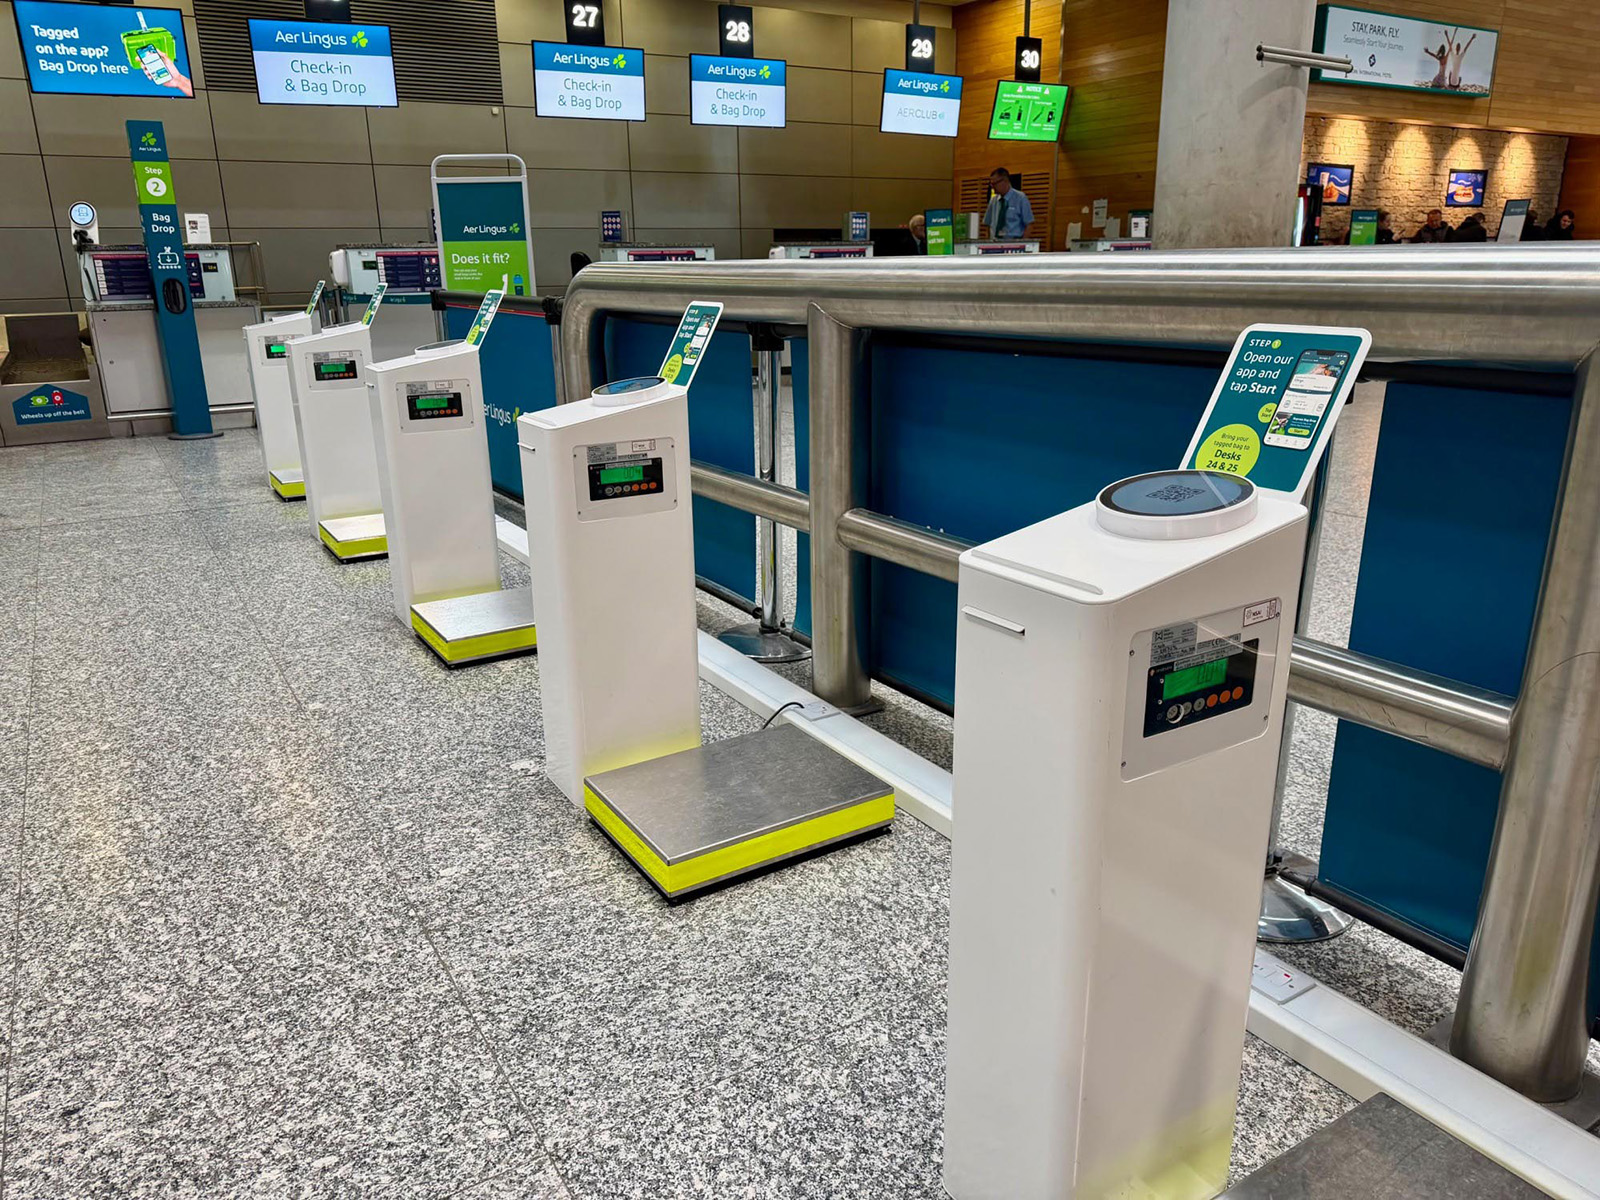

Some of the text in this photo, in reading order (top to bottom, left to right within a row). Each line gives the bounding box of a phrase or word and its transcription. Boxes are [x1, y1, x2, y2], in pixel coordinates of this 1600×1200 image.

[572, 4, 599, 27] 27
[30, 25, 79, 40] Tagged
[726, 20, 750, 42] 28
[275, 30, 347, 49] Aer Lingus
[36, 43, 109, 58] on the app?
[912, 39, 932, 58] 29
[553, 52, 610, 69] Aer Lingus
[1021, 50, 1039, 68] 30
[38, 59, 129, 75] Bag Drop here
[290, 60, 352, 74] Check-in
[708, 64, 756, 80] Aer Lingus
[285, 78, 366, 96] & Bag Drop
[564, 78, 612, 92] Check-in
[898, 78, 938, 93] Aer Lingus
[716, 88, 757, 100] Check-in
[558, 95, 622, 111] & Bag Drop
[710, 103, 766, 118] & Bag Drop
[144, 166, 162, 175] Step
[152, 182, 160, 192] 2
[152, 212, 170, 223] Bag
[152, 224, 175, 234] Drop
[463, 225, 507, 235] Aer Lingus
[452, 253, 510, 264] Does it fit?
[1249, 339, 1272, 347] STEP
[1244, 351, 1294, 364] Open our
[1236, 368, 1281, 379] app and
[1230, 381, 1277, 394] tap Start
[1221, 433, 1236, 441] Bring
[1214, 449, 1242, 461] Desks
[1206, 460, 1238, 472] 24 & 25
